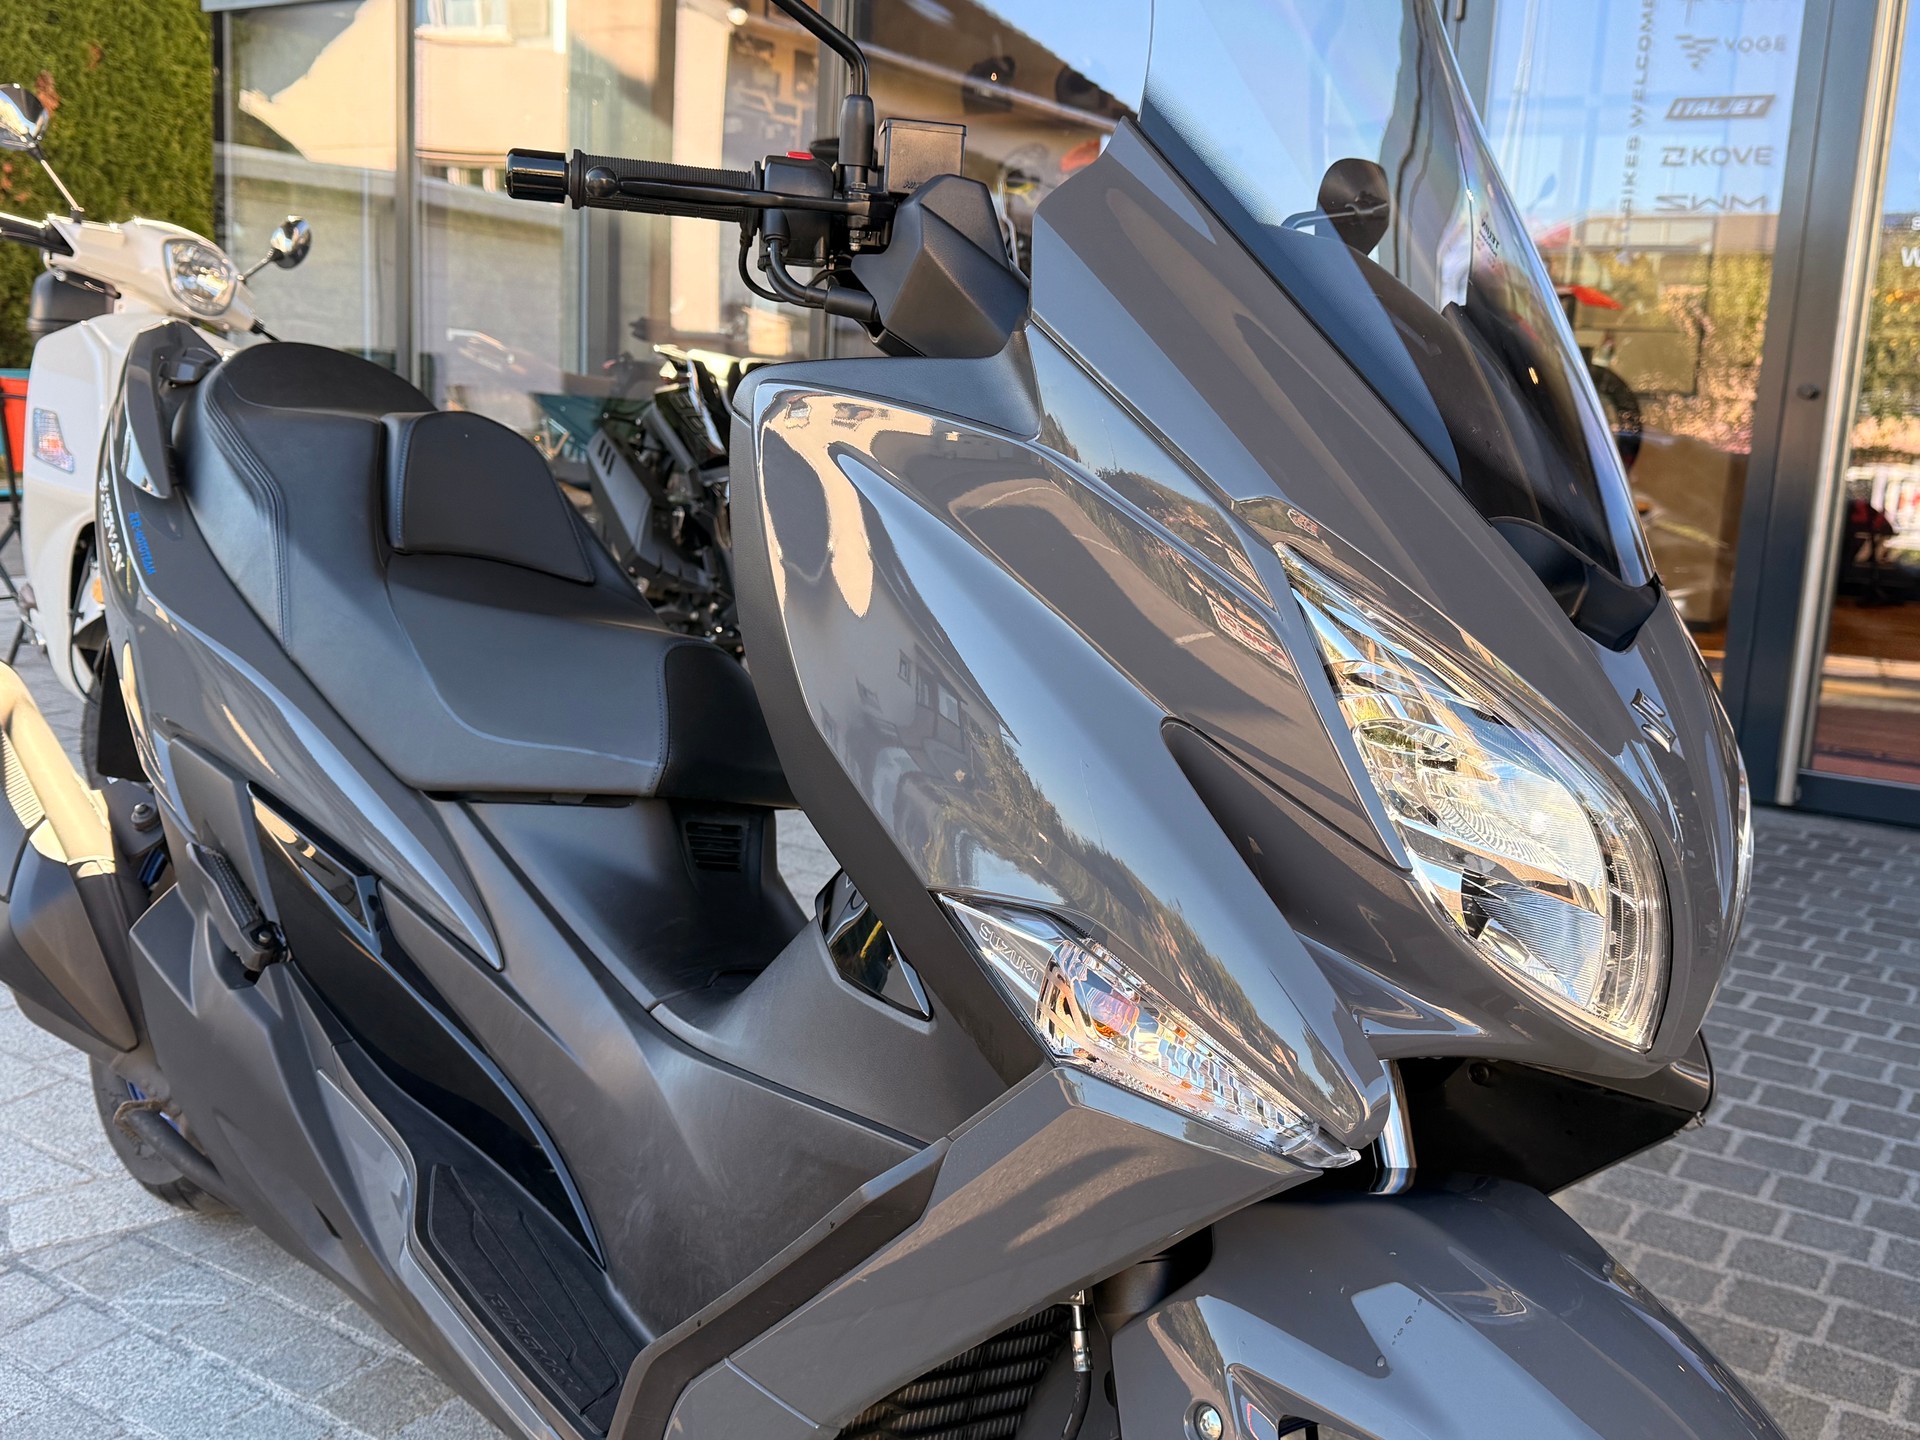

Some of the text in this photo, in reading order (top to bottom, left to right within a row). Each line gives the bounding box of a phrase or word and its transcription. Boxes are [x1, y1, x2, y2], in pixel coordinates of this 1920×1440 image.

[1723, 36, 1787, 55] VOGE
[1669, 97, 1770, 118] ITALJET
[1690, 145, 1774, 166] KOVE
[979, 922, 1039, 985] SUZUKI
